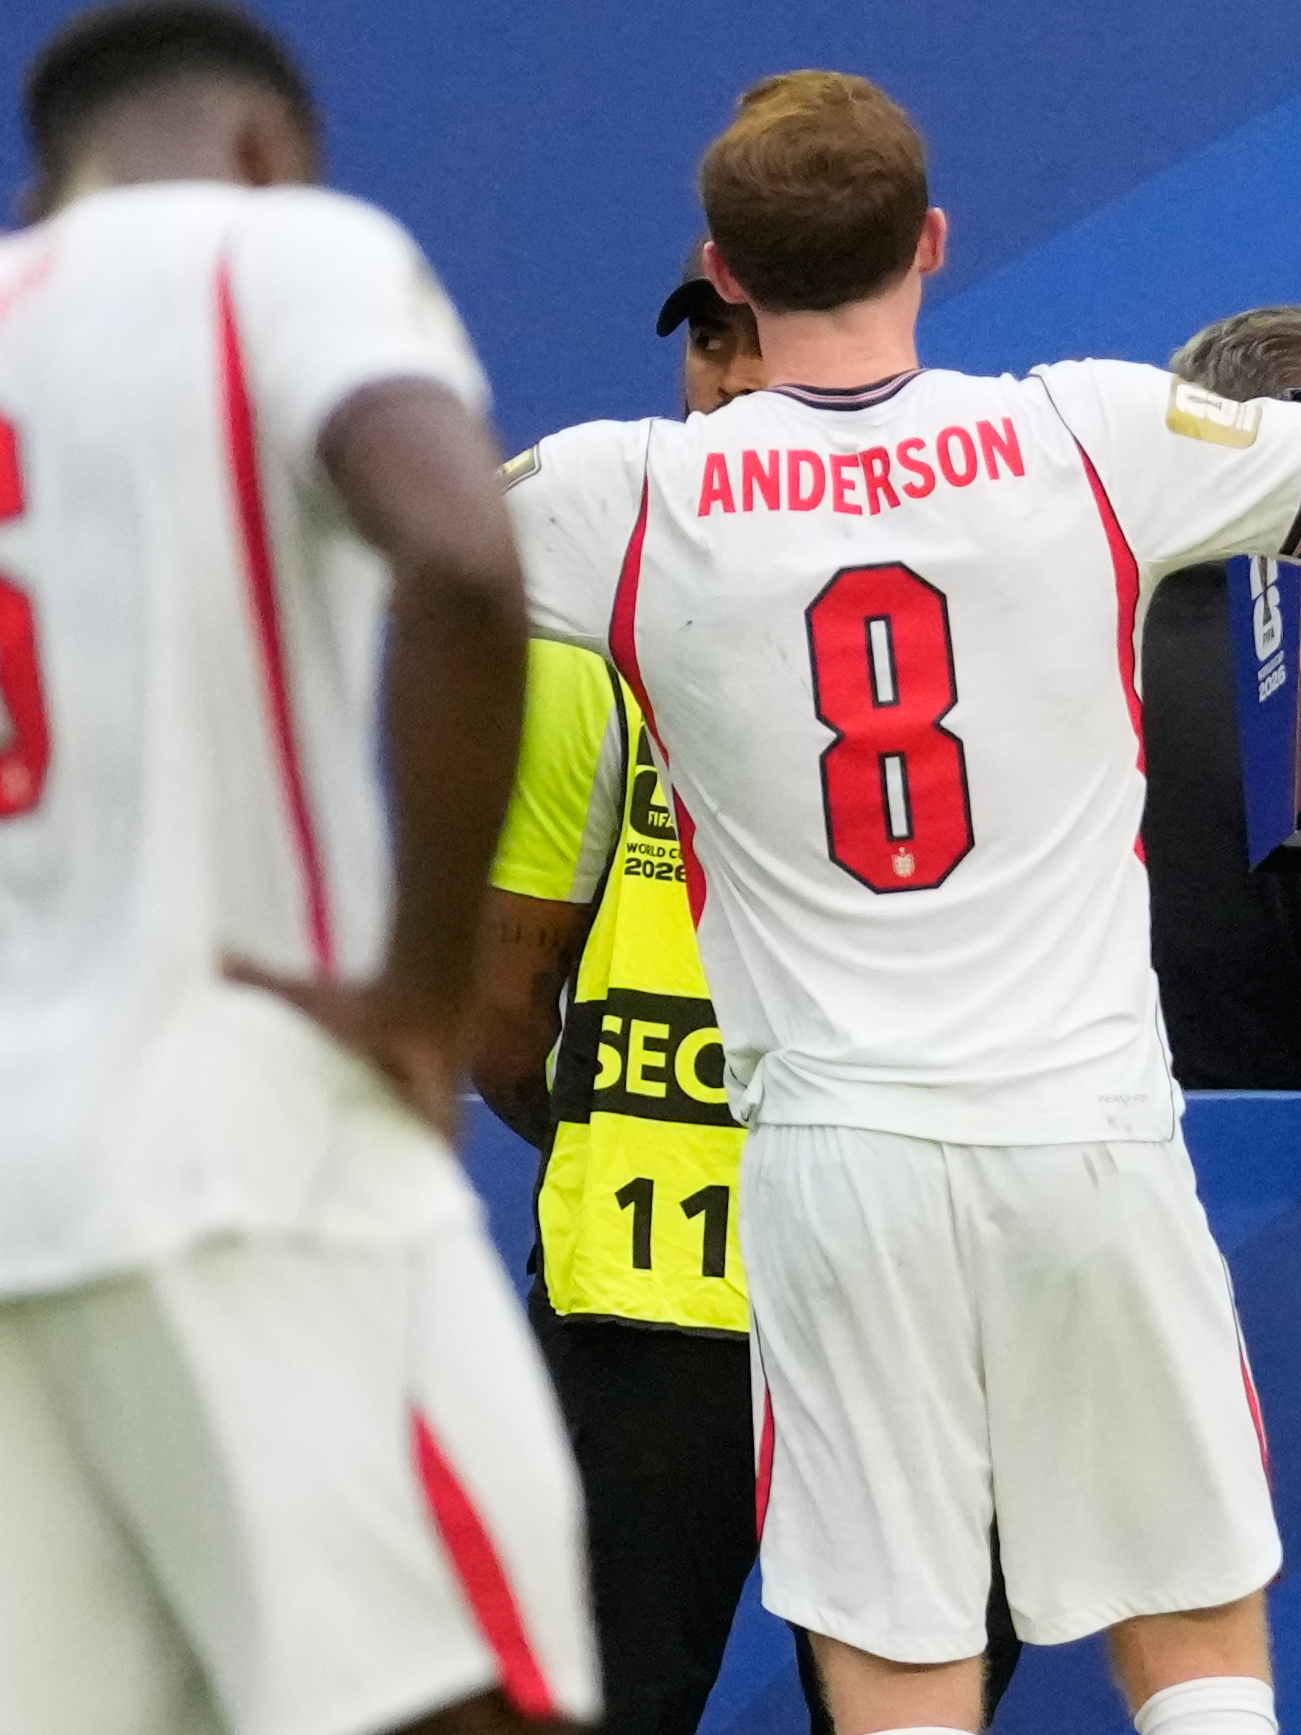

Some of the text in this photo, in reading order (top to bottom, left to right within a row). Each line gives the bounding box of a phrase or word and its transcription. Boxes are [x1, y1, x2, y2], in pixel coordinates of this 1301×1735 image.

[697, 417, 1026, 517] ANDERSON
[804, 561, 974, 894] 8
[624, 857, 687, 883] 2026
[626, 843, 666, 858] WORLD
[593, 1014, 729, 1104] SEC
[614, 1177, 730, 1278] 11
